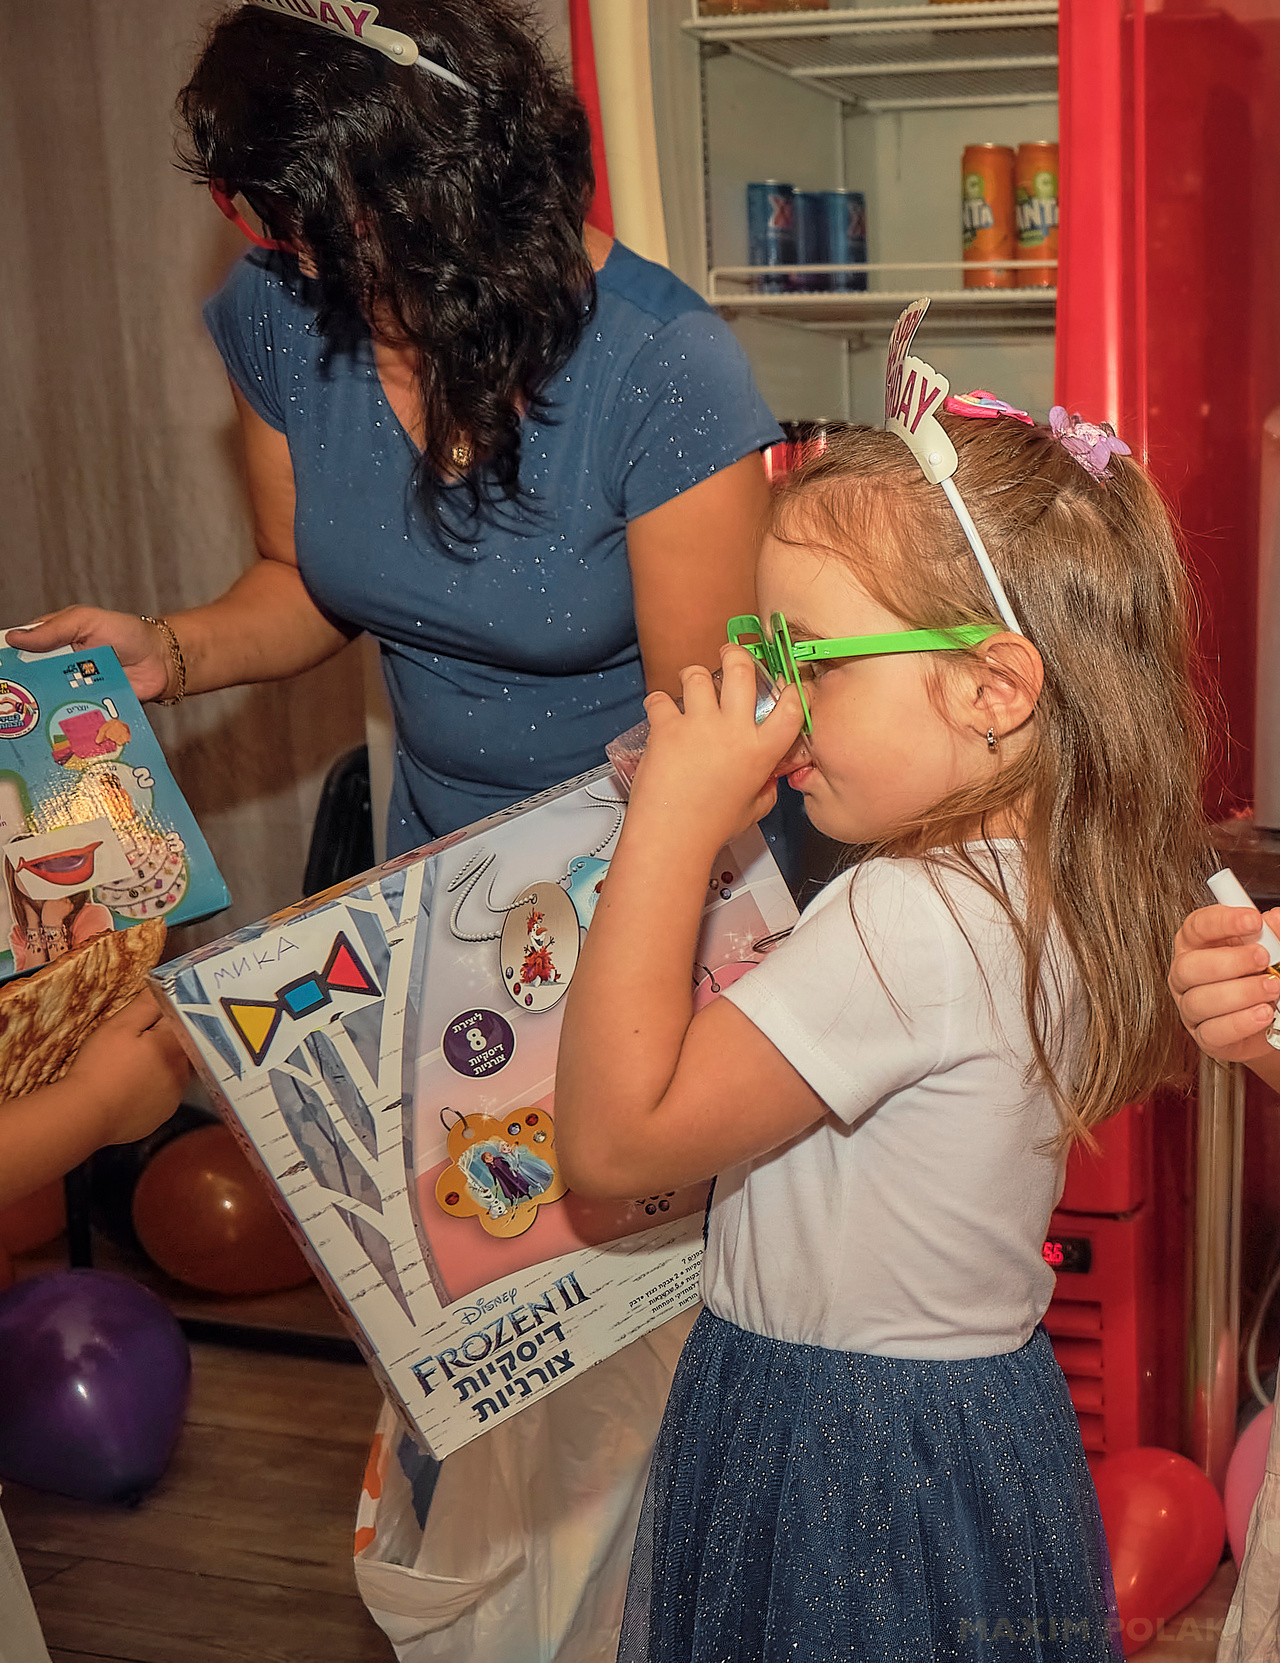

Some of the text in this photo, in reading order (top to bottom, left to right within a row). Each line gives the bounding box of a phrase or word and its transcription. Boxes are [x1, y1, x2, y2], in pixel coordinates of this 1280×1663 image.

[452, 1012, 483, 1034] ליצירת
[466, 1027, 487, 1051] 8
[468, 1043, 504, 1066] דיסקיות
[473, 1054, 506, 1075] צורניות
[687, 1249, 704, 1262] בפנים
[658, 1277, 674, 1289] אבקת
[651, 1297, 674, 1313] מפתחות
[678, 1292, 698, 1306] הוראות
[409, 1270, 591, 1398] FROZEN II
[452, 1321, 566, 1401] דיסקיות
[471, 1349, 576, 1423] צורניות
